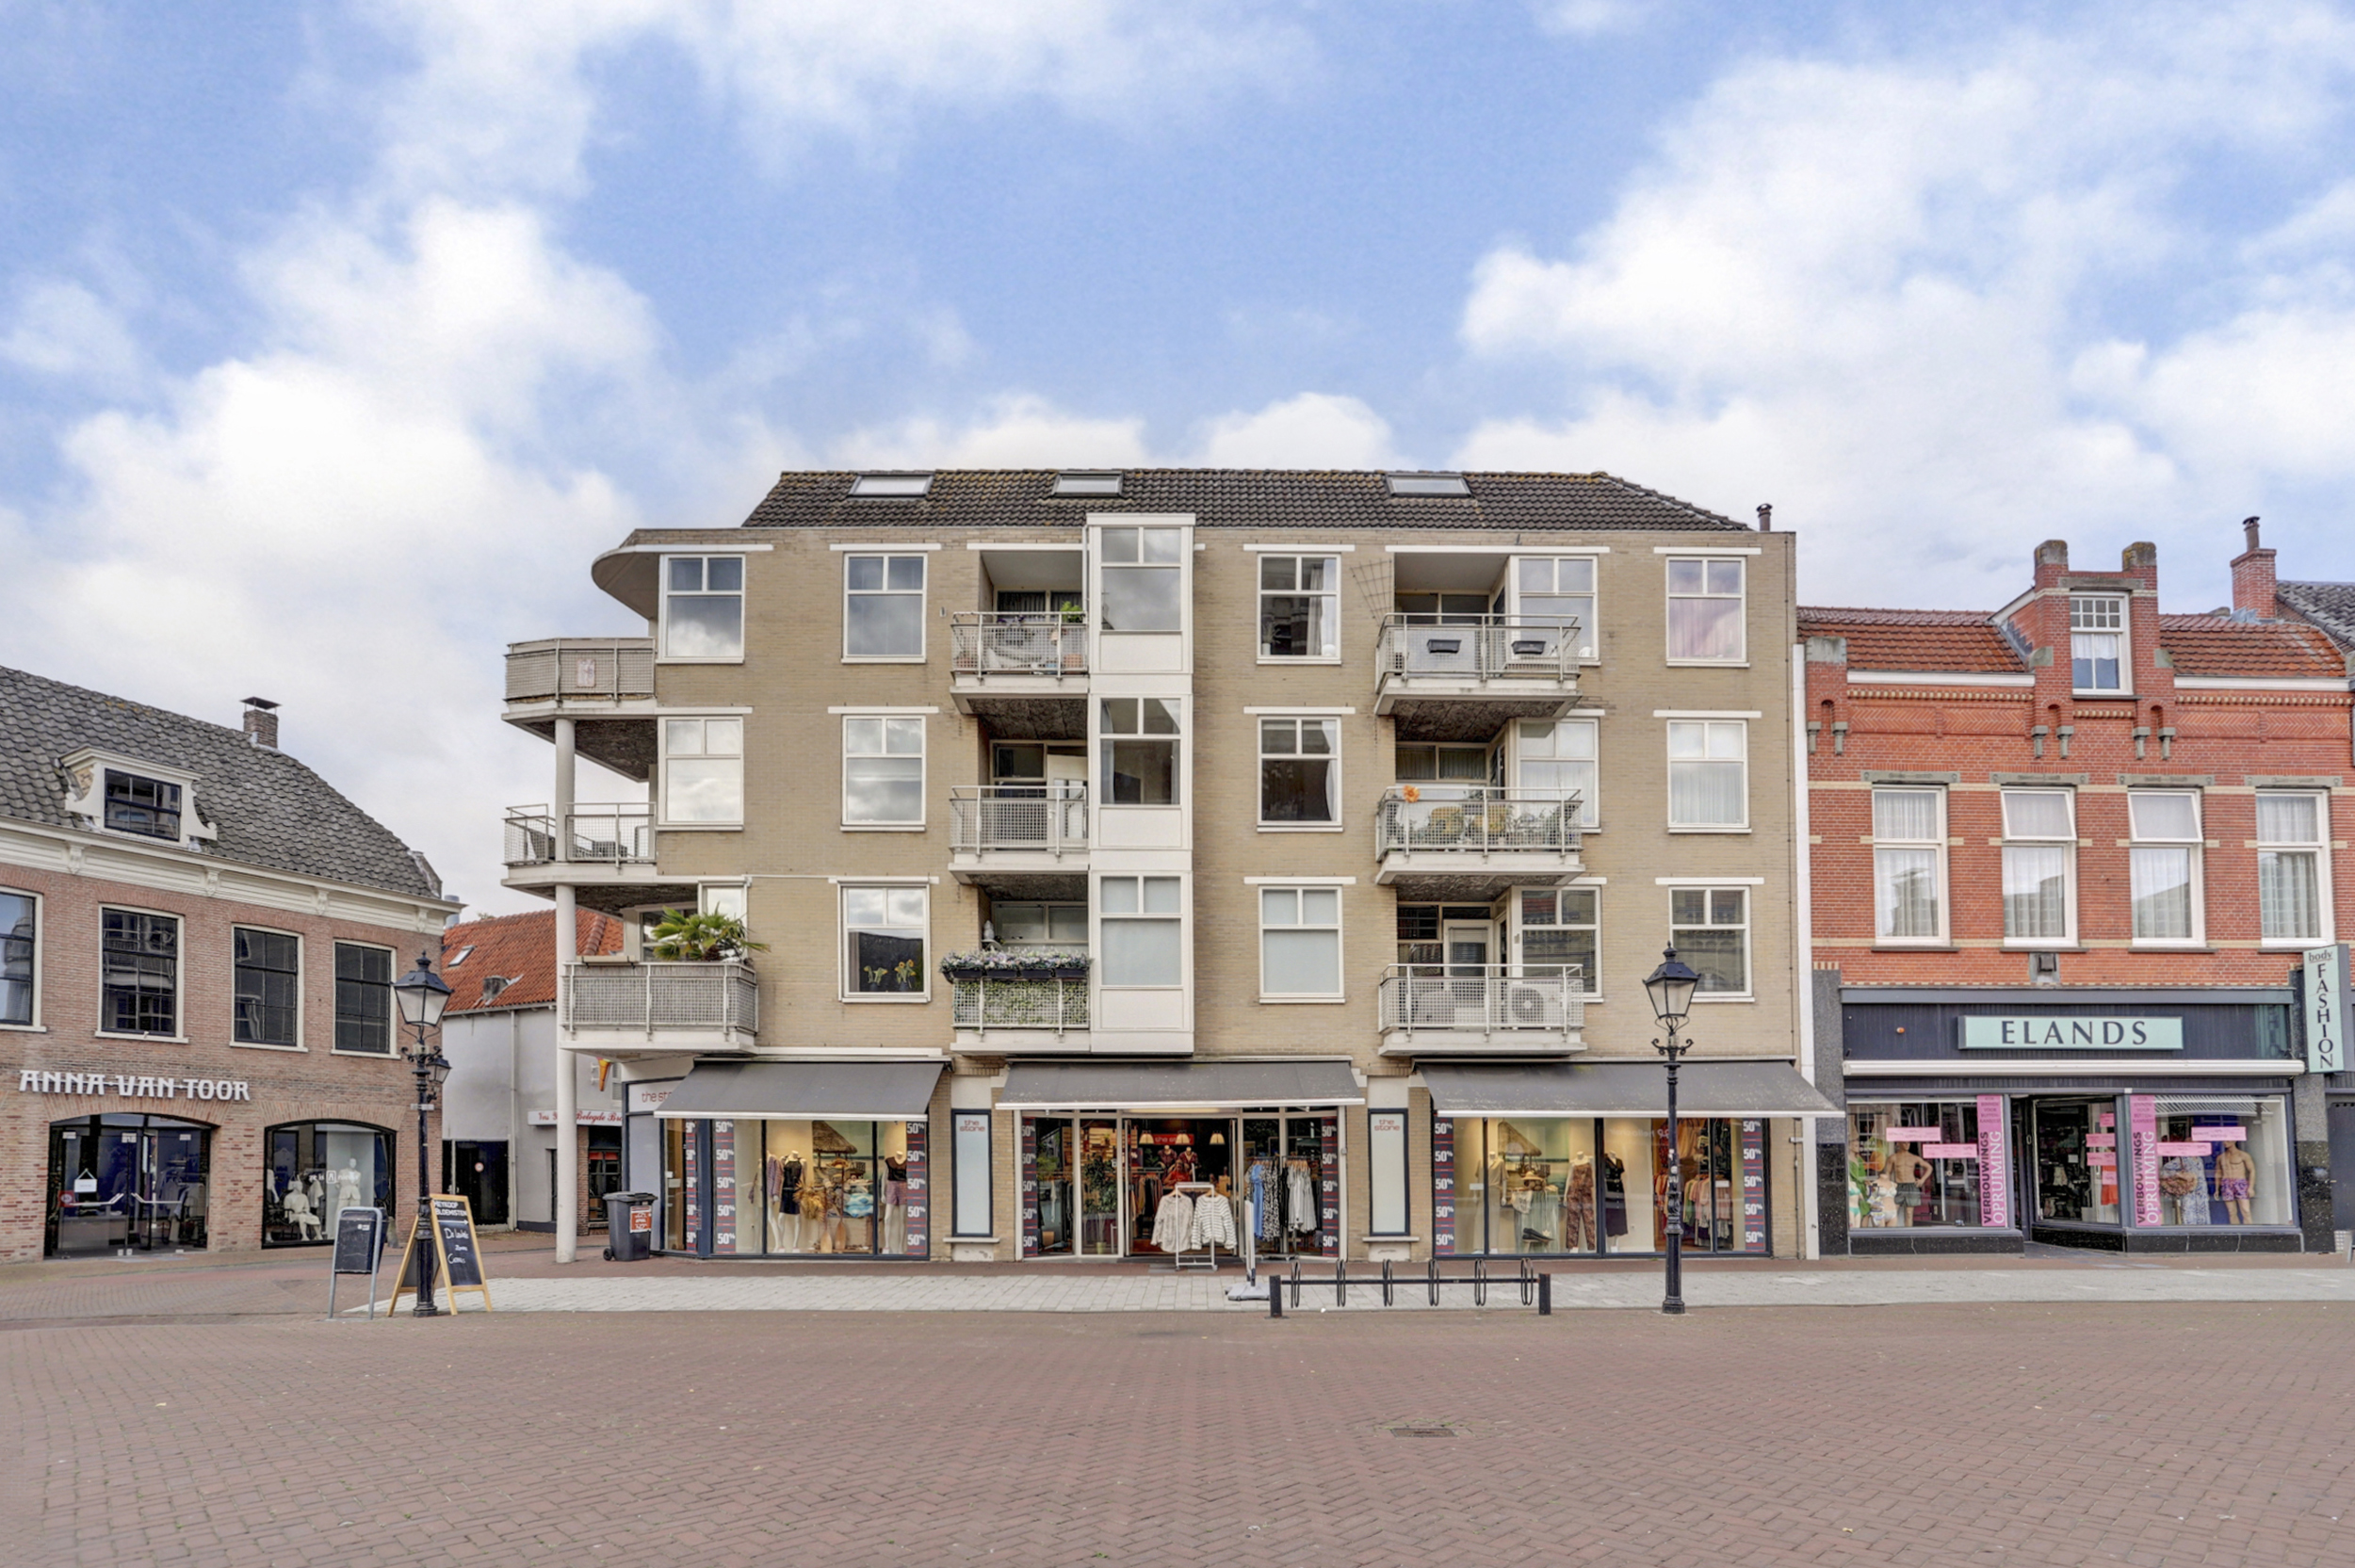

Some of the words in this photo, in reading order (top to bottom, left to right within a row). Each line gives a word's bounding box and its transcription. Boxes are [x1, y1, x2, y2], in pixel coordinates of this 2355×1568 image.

[2308, 949, 2333, 962] body
[2316, 963, 2333, 1069] FASHION
[2002, 1020, 2147, 1045] ELANDS
[19, 1070, 106, 1095] ANNA
[115, 1075, 174, 1098] VAN
[183, 1078, 250, 1101] TOOR
[642, 1091, 657, 1103] the
[715, 1121, 733, 1133] 50%
[907, 1123, 925, 1134] 50%
[1322, 1125, 1337, 1137] 50%
[1435, 1123, 1453, 1134] 50%
[1743, 1121, 1761, 1132] 50%
[716, 1149, 734, 1161] 50%
[907, 1150, 925, 1162] 50%
[1322, 1153, 1337, 1164] 50%
[1435, 1150, 1453, 1162] 50%
[1743, 1148, 1761, 1160] 50%
[716, 1177, 735, 1188] 50%
[1744, 1176, 1762, 1187] 50%
[1980, 1131, 1991, 1223] VERBOUWINGS
[1990, 1131, 2005, 1224] OPRUIMING
[2133, 1131, 2146, 1223] VERBOUWINGS
[2142, 1131, 2159, 1224] OPRUIMING
[907, 1178, 926, 1189] 50%
[1323, 1180, 1338, 1192] 50%
[1435, 1178, 1454, 1190] 50%
[717, 1204, 736, 1216] 50%
[907, 1206, 926, 1218] 50%
[1323, 1208, 1338, 1219] 50%
[1435, 1206, 1454, 1218] 50%
[1745, 1203, 1763, 1215] 50%
[717, 1232, 736, 1245] 50%
[907, 1234, 926, 1245] 50%
[1323, 1236, 1338, 1247] 50%
[1436, 1234, 1454, 1245] 50%
[1745, 1231, 1763, 1243] 50%
